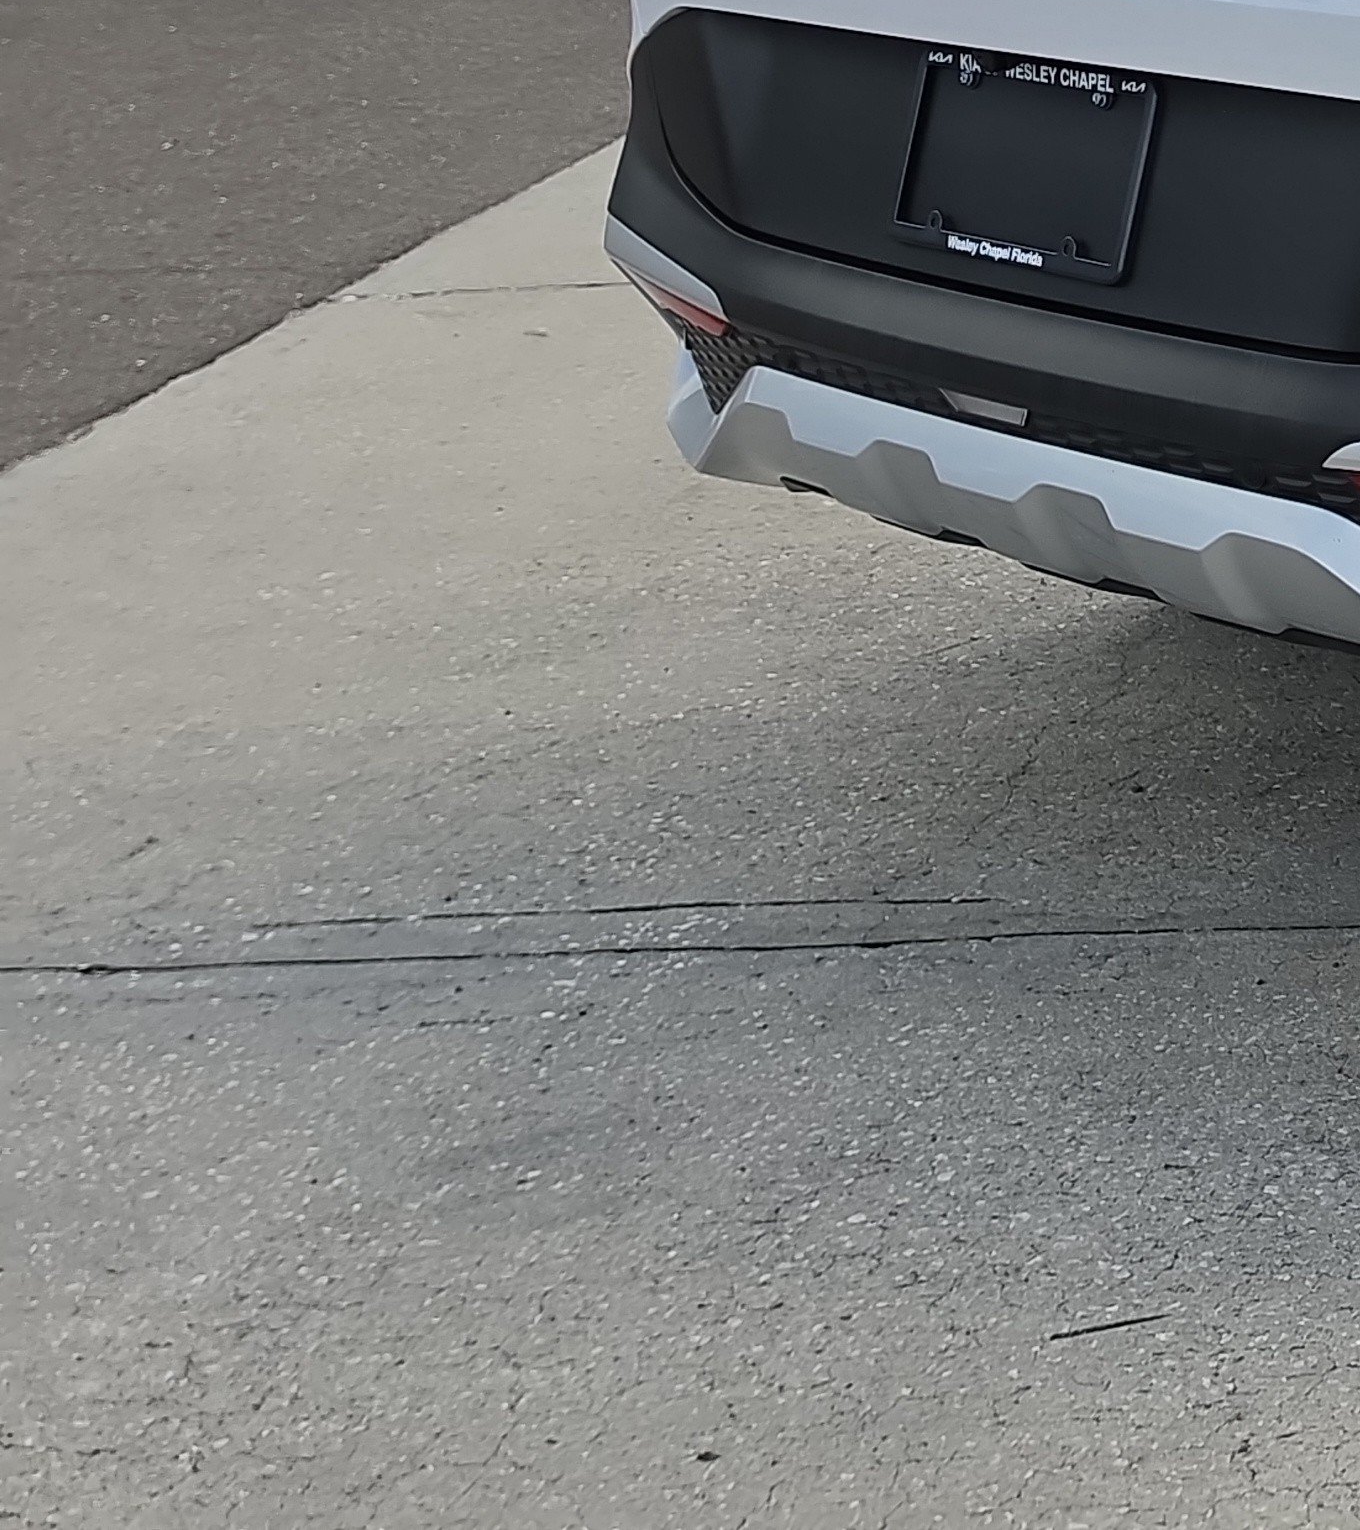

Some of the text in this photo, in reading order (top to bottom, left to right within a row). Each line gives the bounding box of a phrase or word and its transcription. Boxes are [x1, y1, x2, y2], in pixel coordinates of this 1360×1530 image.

[960, 53, 982, 73] KIA
[1059, 70, 1114, 93] CHAPEL
[947, 235, 1043, 267] Wesley Chapel Florida
